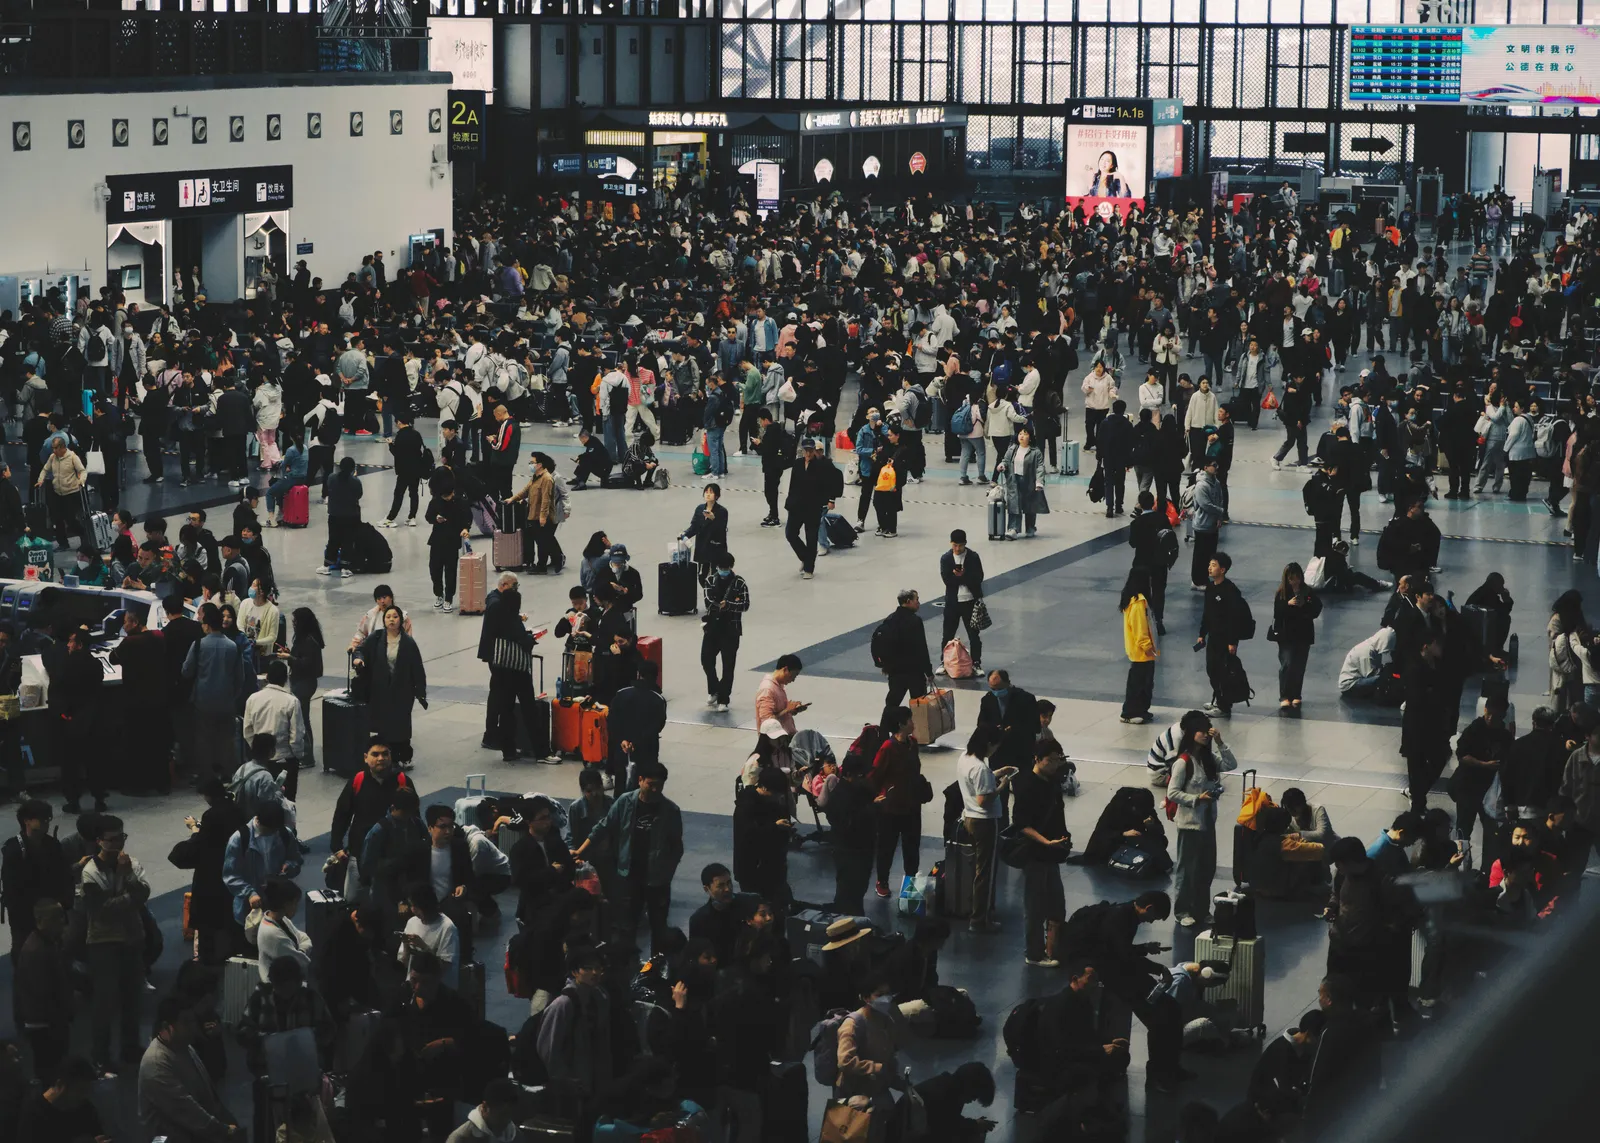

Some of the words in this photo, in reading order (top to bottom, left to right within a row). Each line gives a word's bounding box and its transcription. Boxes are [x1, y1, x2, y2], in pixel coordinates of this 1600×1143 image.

[1506, 44, 1576, 54] 文明伴我行
[1506, 62, 1574, 71] 公德在我心
[452, 101, 478, 125] 2A
[649, 112, 682, 126] 姑苏好礼
[452, 132, 479, 142] 检票口
[1078, 129, 1137, 140] #招行卡好用#
[212, 180, 240, 193] 女卫生间
[268, 183, 285, 193] 饮用水
[137, 192, 156, 203] 饮用水
